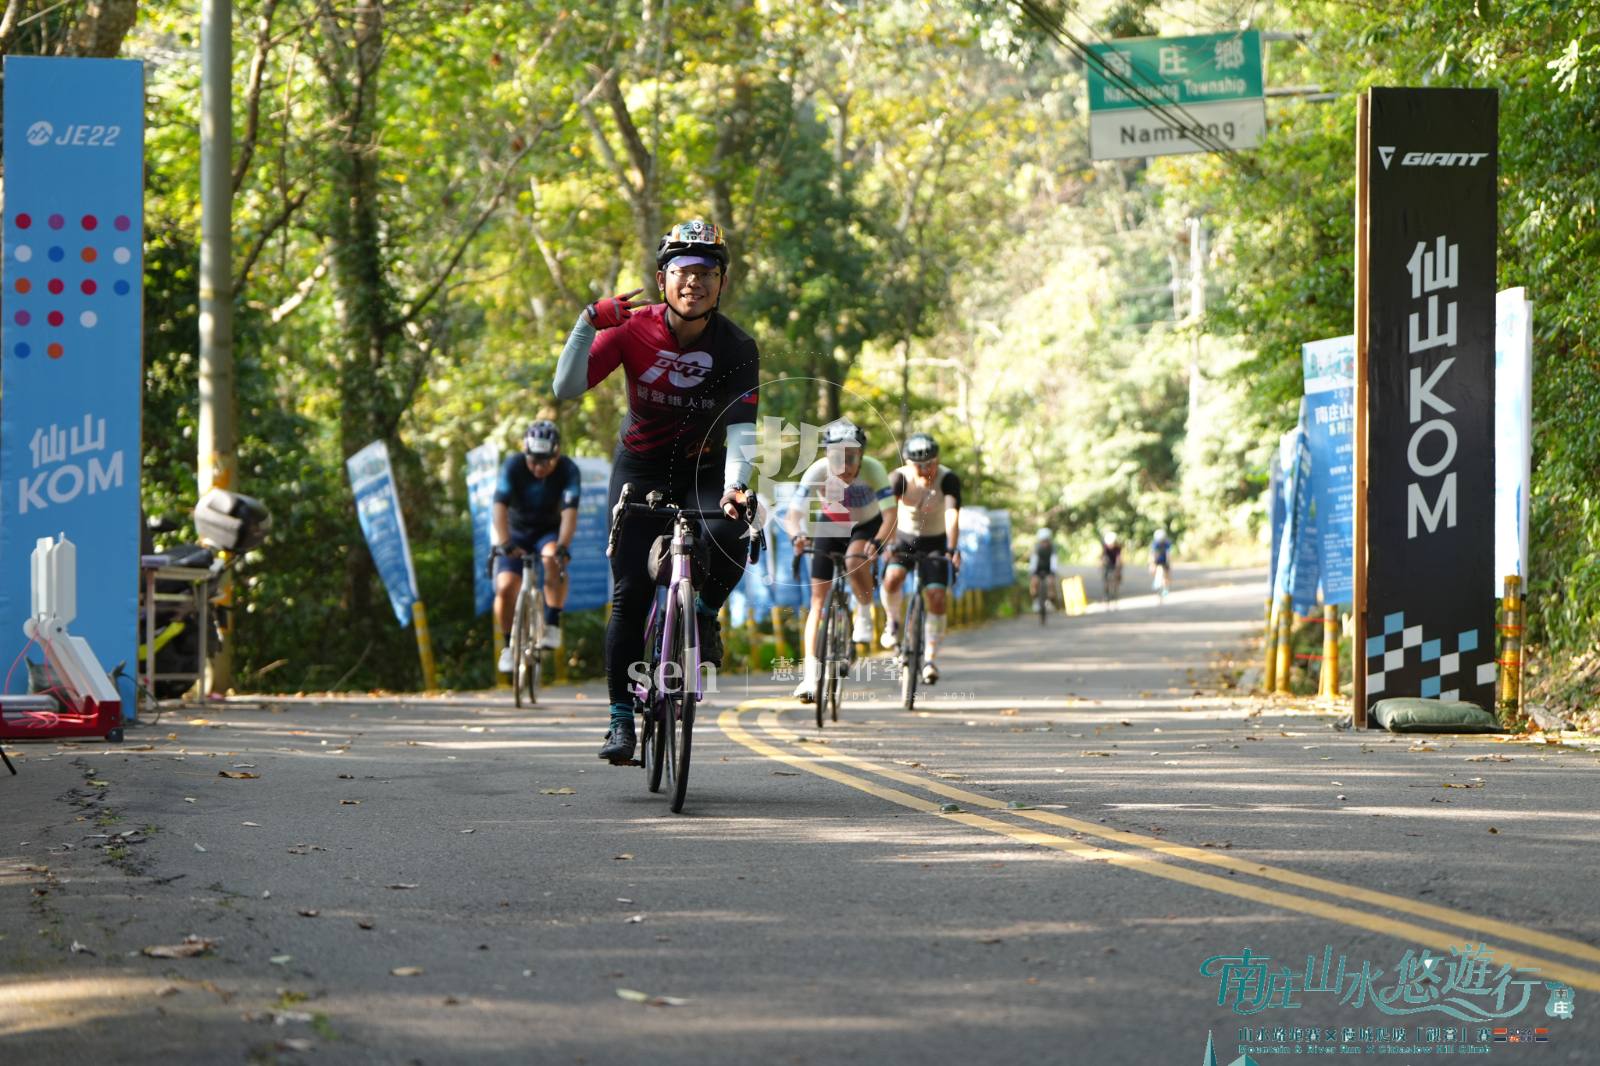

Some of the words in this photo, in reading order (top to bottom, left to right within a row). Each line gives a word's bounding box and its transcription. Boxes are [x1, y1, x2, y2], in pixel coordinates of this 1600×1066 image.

[1184, 78, 1246, 96] Township
[55, 124, 121, 148] JE22
[1401, 152, 1489, 167] GIANT
[29, 414, 106, 468] 仙山
[18, 450, 124, 514] KOM
